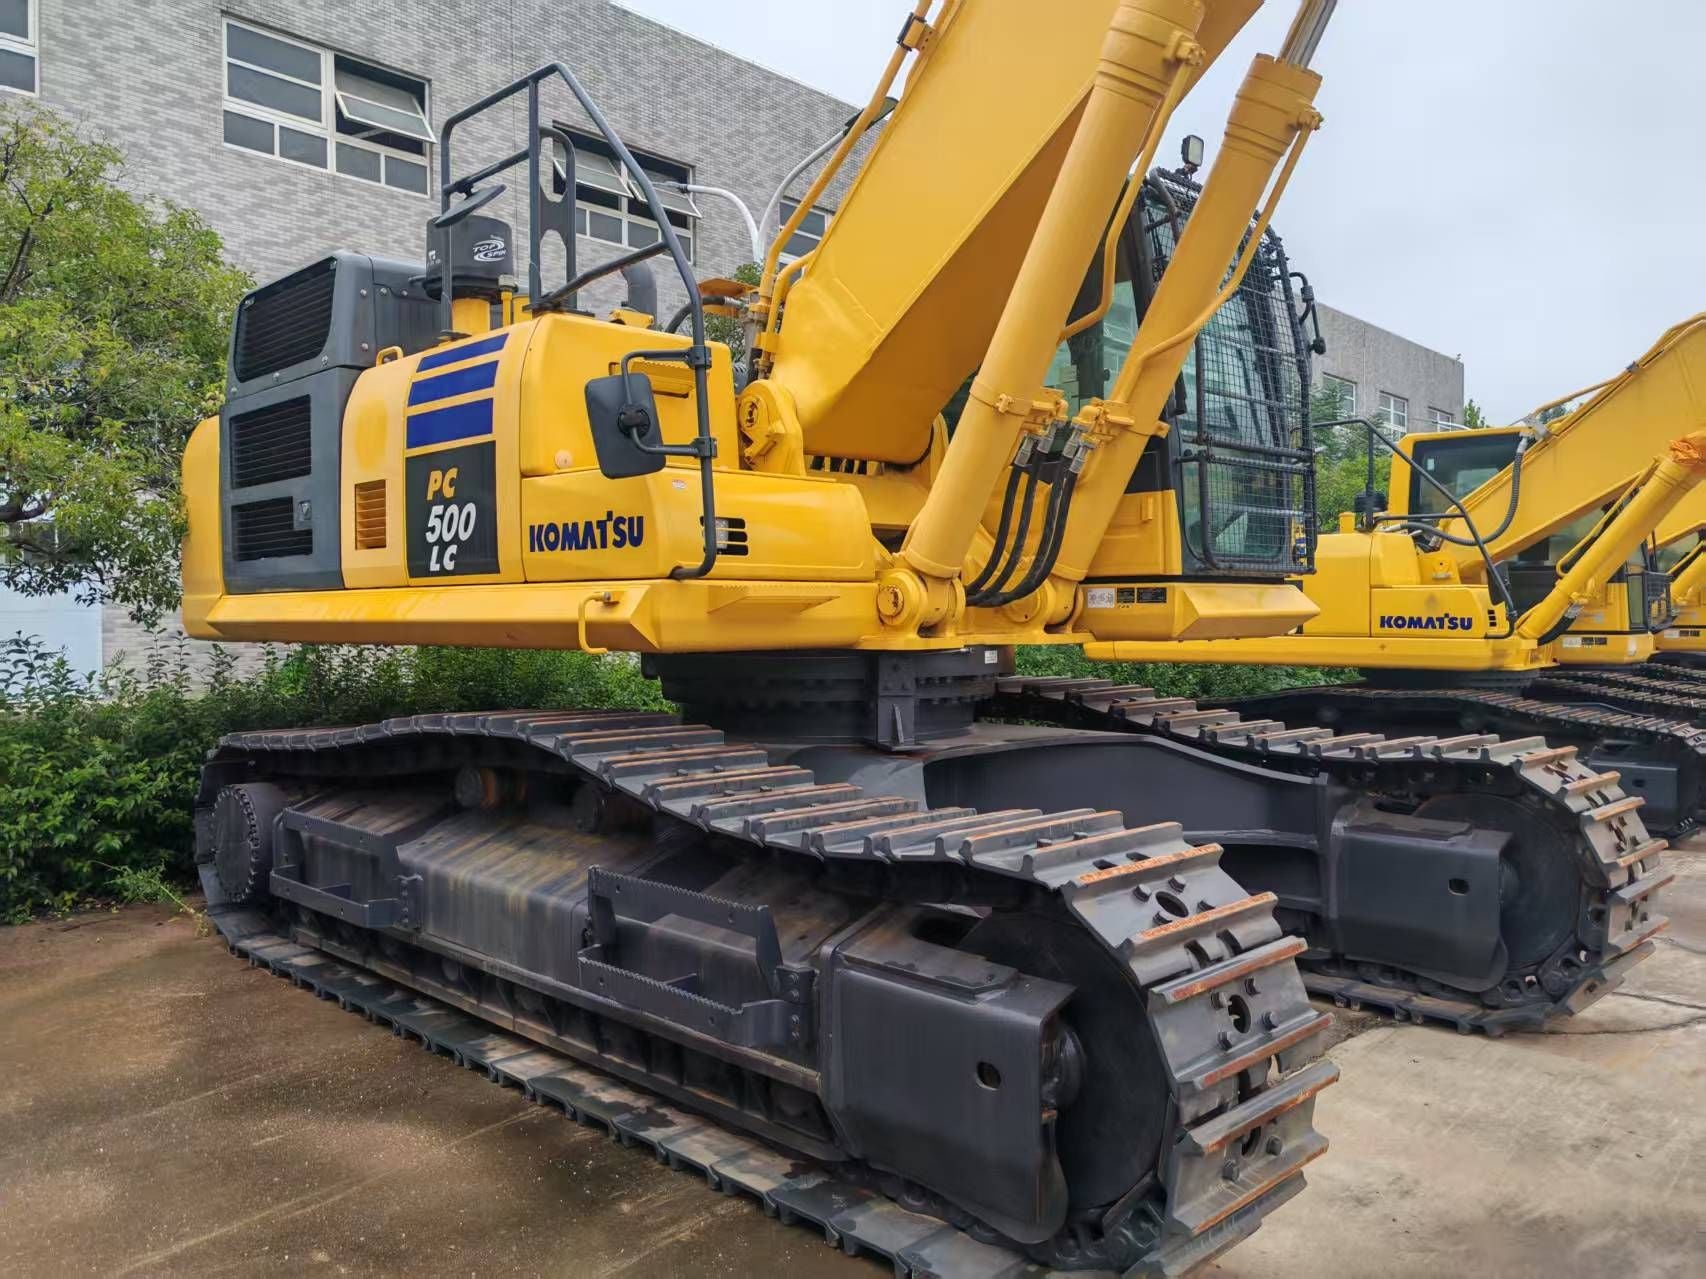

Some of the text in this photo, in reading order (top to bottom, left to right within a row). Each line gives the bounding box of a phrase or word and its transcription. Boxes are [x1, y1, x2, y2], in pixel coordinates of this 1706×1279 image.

[473, 244, 499, 252] TOP
[487, 250, 506, 258] SPIN
[427, 467, 459, 501] PC
[425, 502, 477, 543] 500
[529, 510, 644, 552] KOMATSU
[429, 544, 458, 572] LC
[1380, 613, 1473, 631] KOMATSU
